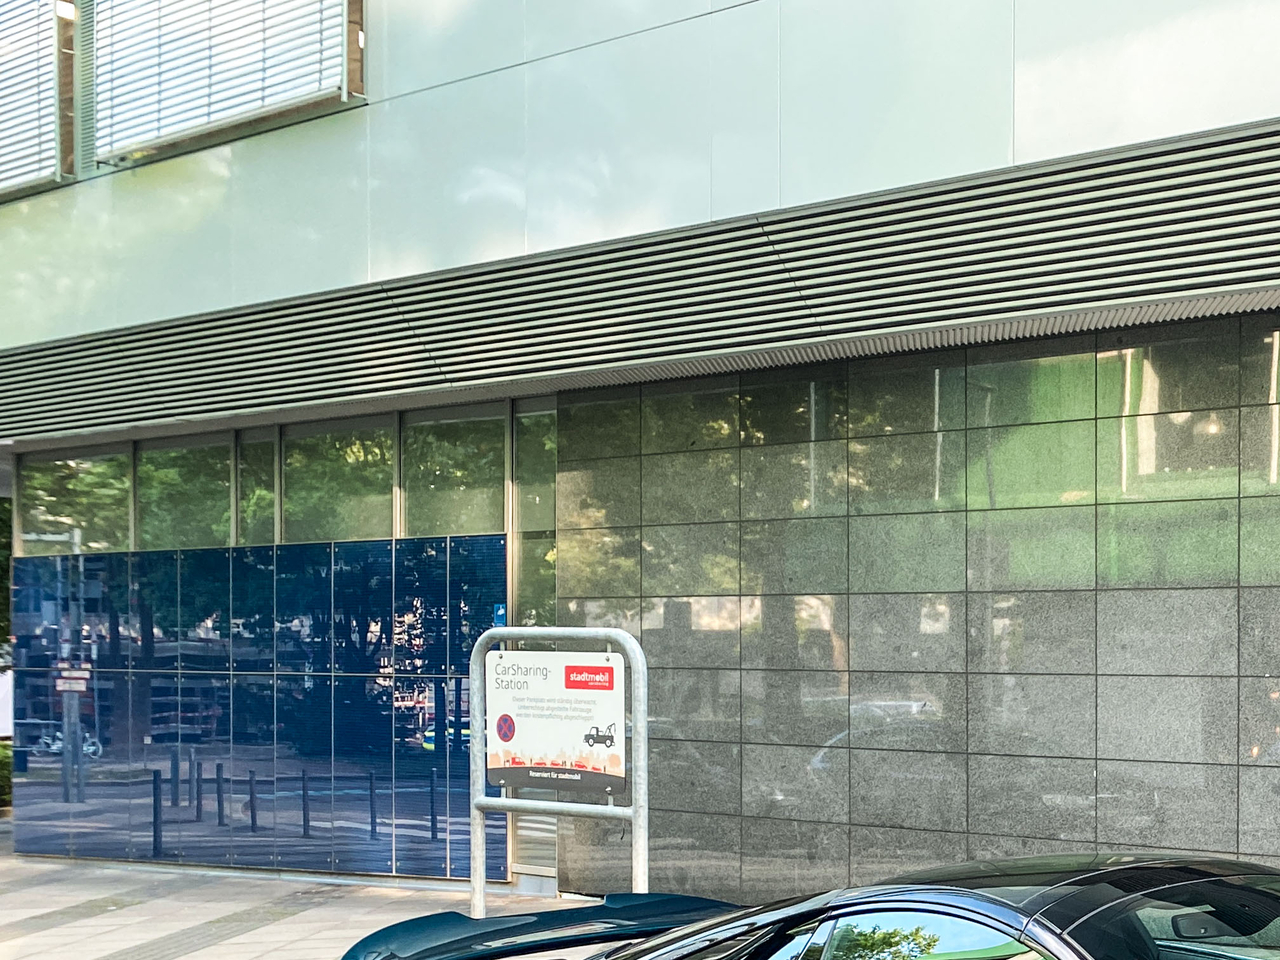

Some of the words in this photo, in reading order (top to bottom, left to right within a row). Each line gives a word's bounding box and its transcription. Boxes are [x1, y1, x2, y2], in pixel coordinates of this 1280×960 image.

[495, 663, 552, 680] CarSharing-
[570, 672, 609, 682] stadtmobil
[495, 678, 529, 690] Station
